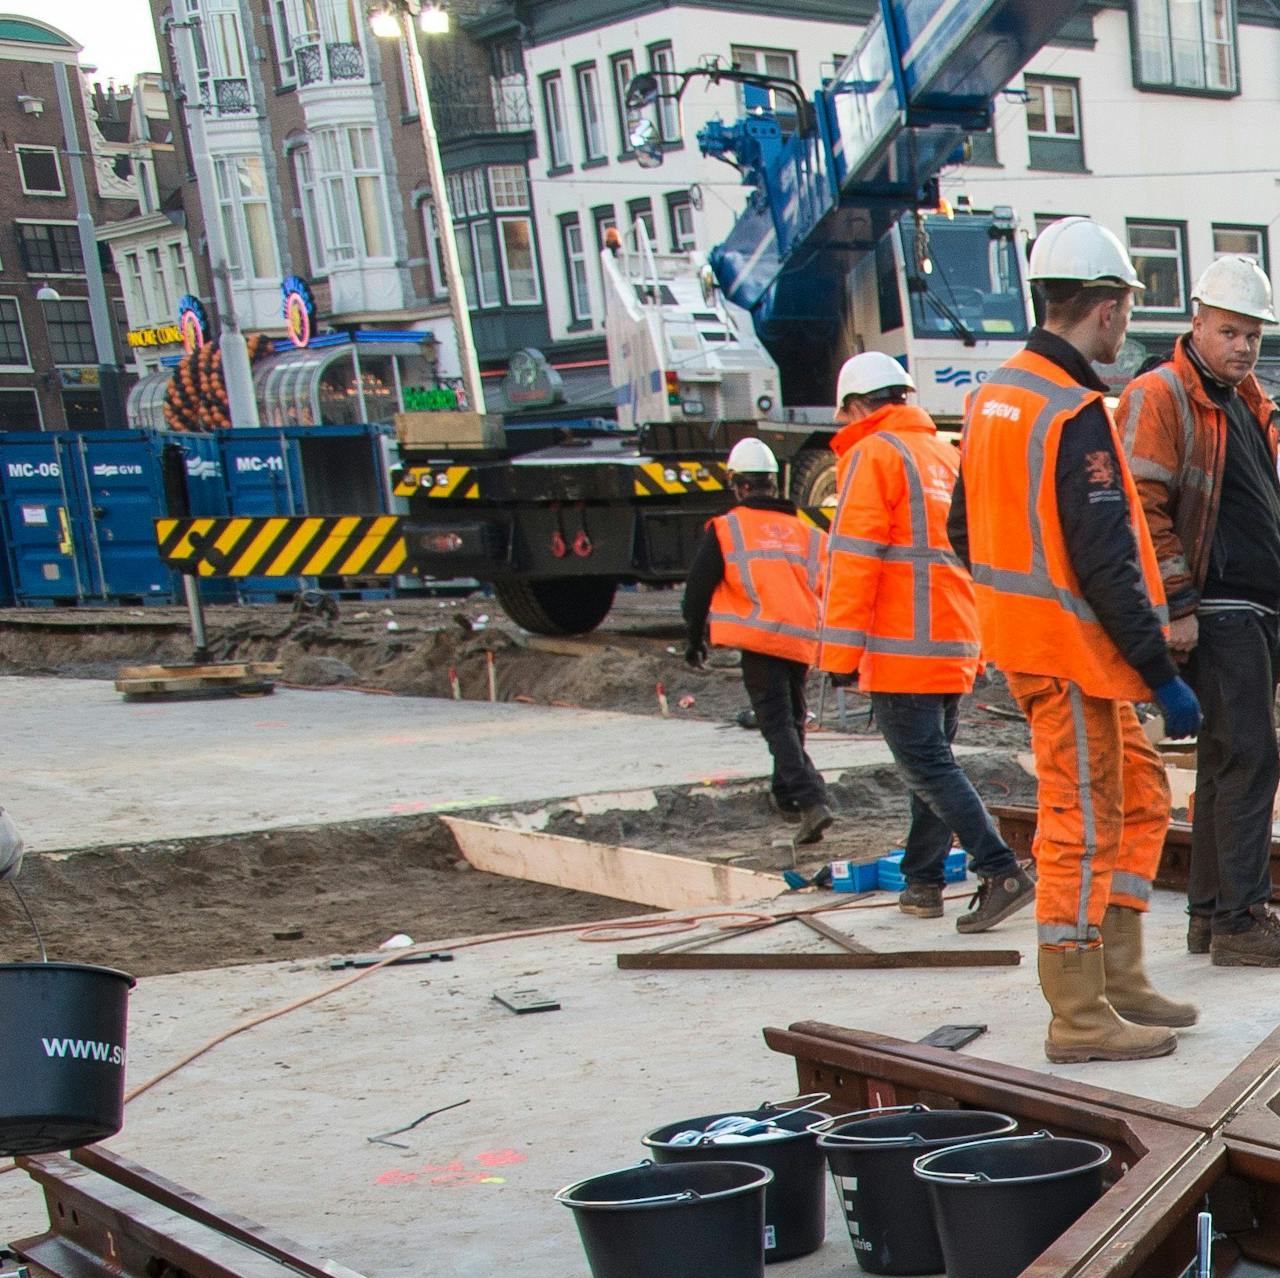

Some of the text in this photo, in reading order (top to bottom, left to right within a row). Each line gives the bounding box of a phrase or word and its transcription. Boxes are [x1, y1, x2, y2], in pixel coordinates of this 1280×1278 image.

[997, 403, 1022, 423] GVB
[8, 463, 60, 477] MC-06
[119, 464, 143, 475] GVB
[236, 456, 285, 472] MC-11
